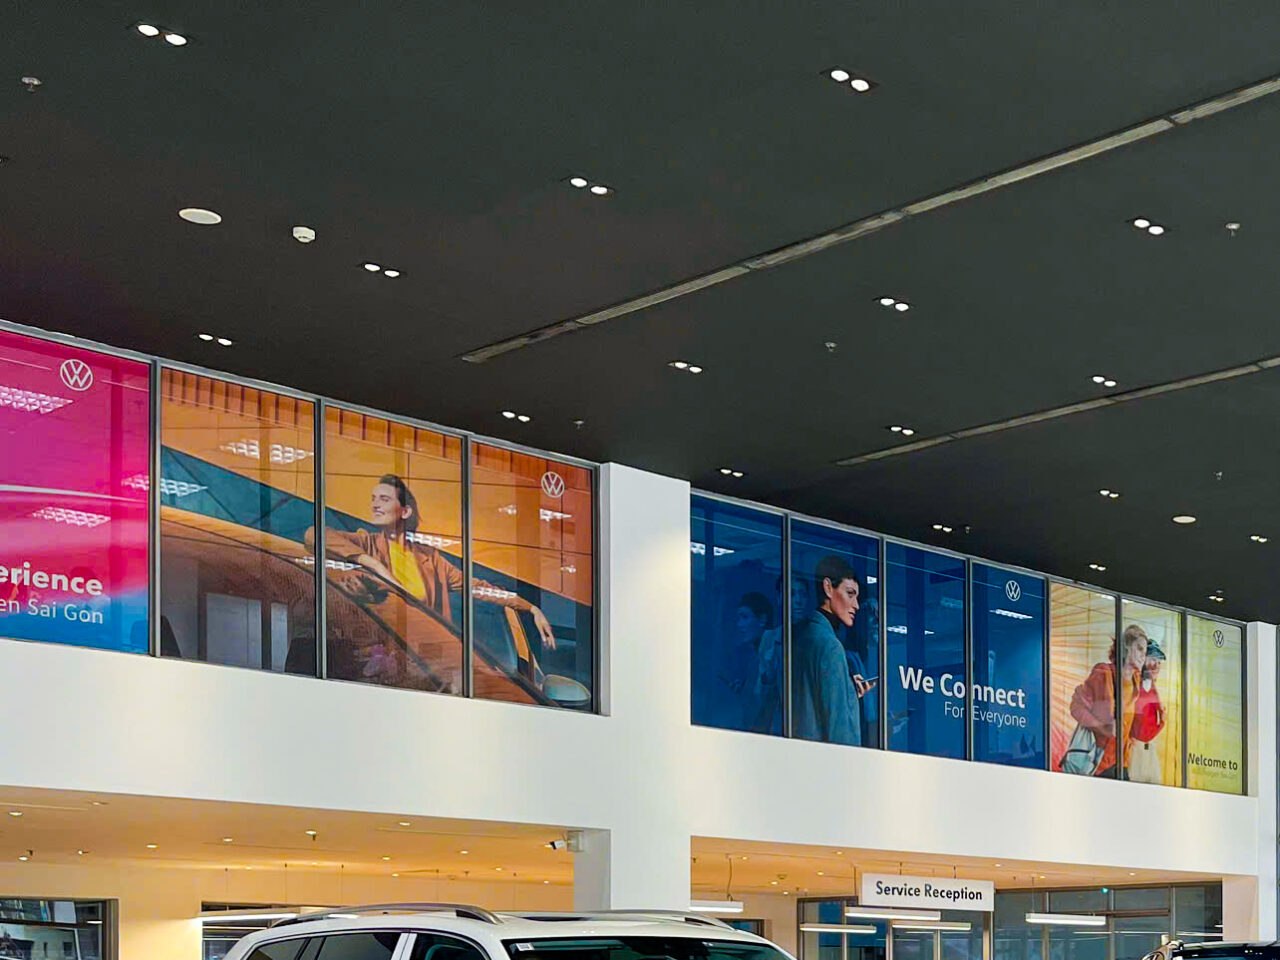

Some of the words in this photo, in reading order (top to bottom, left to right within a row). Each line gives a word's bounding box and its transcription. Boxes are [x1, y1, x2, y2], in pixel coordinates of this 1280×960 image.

[0, 561, 103, 596] erience
[27, 598, 57, 619] Sai
[64, 603, 104, 625] Gon
[899, 665, 935, 694] We
[940, 673, 1026, 709] Connect
[944, 701, 966, 718] For
[972, 705, 1027, 728] Everyone
[1187, 752, 1227, 769] Welcome
[1228, 760, 1239, 771] to
[876, 880, 921, 897] Service
[924, 883, 983, 902] Reception
